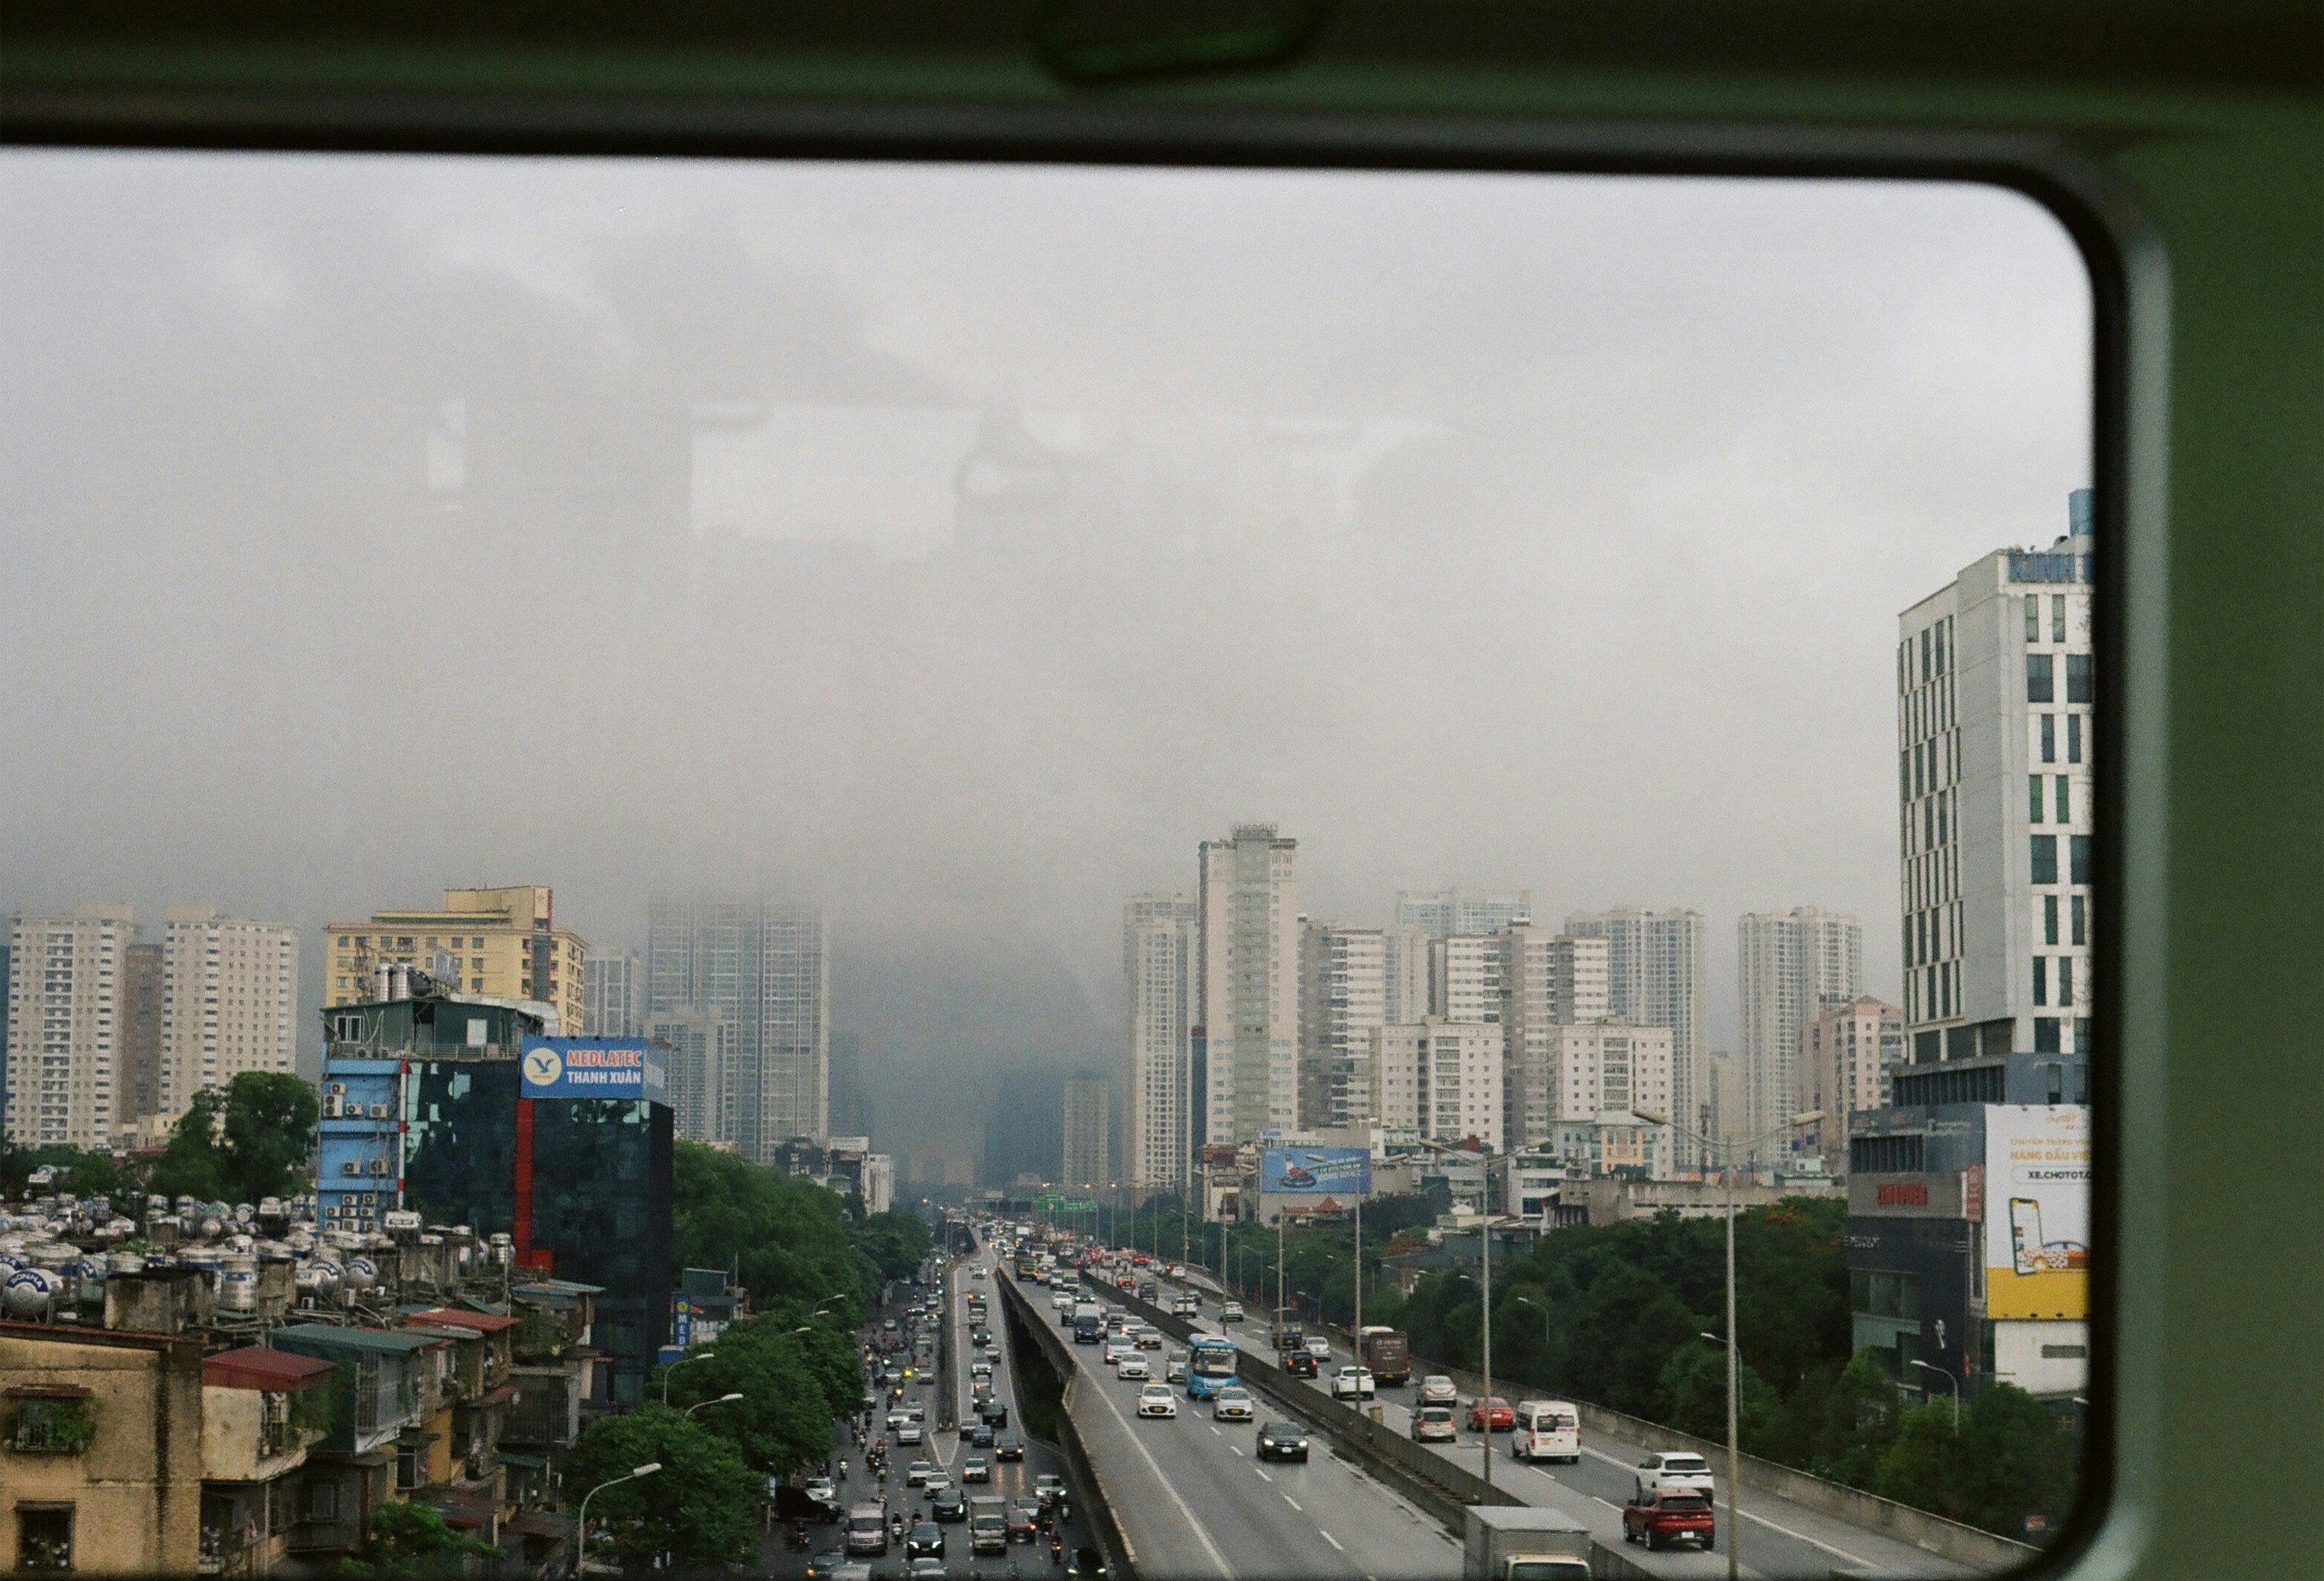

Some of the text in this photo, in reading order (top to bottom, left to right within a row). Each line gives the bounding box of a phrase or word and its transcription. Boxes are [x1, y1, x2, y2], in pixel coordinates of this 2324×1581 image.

[566, 1050, 642, 1066] MEDLATEC
[567, 1071, 607, 1083] THANH
[610, 1069, 641, 1084] XUÂN
